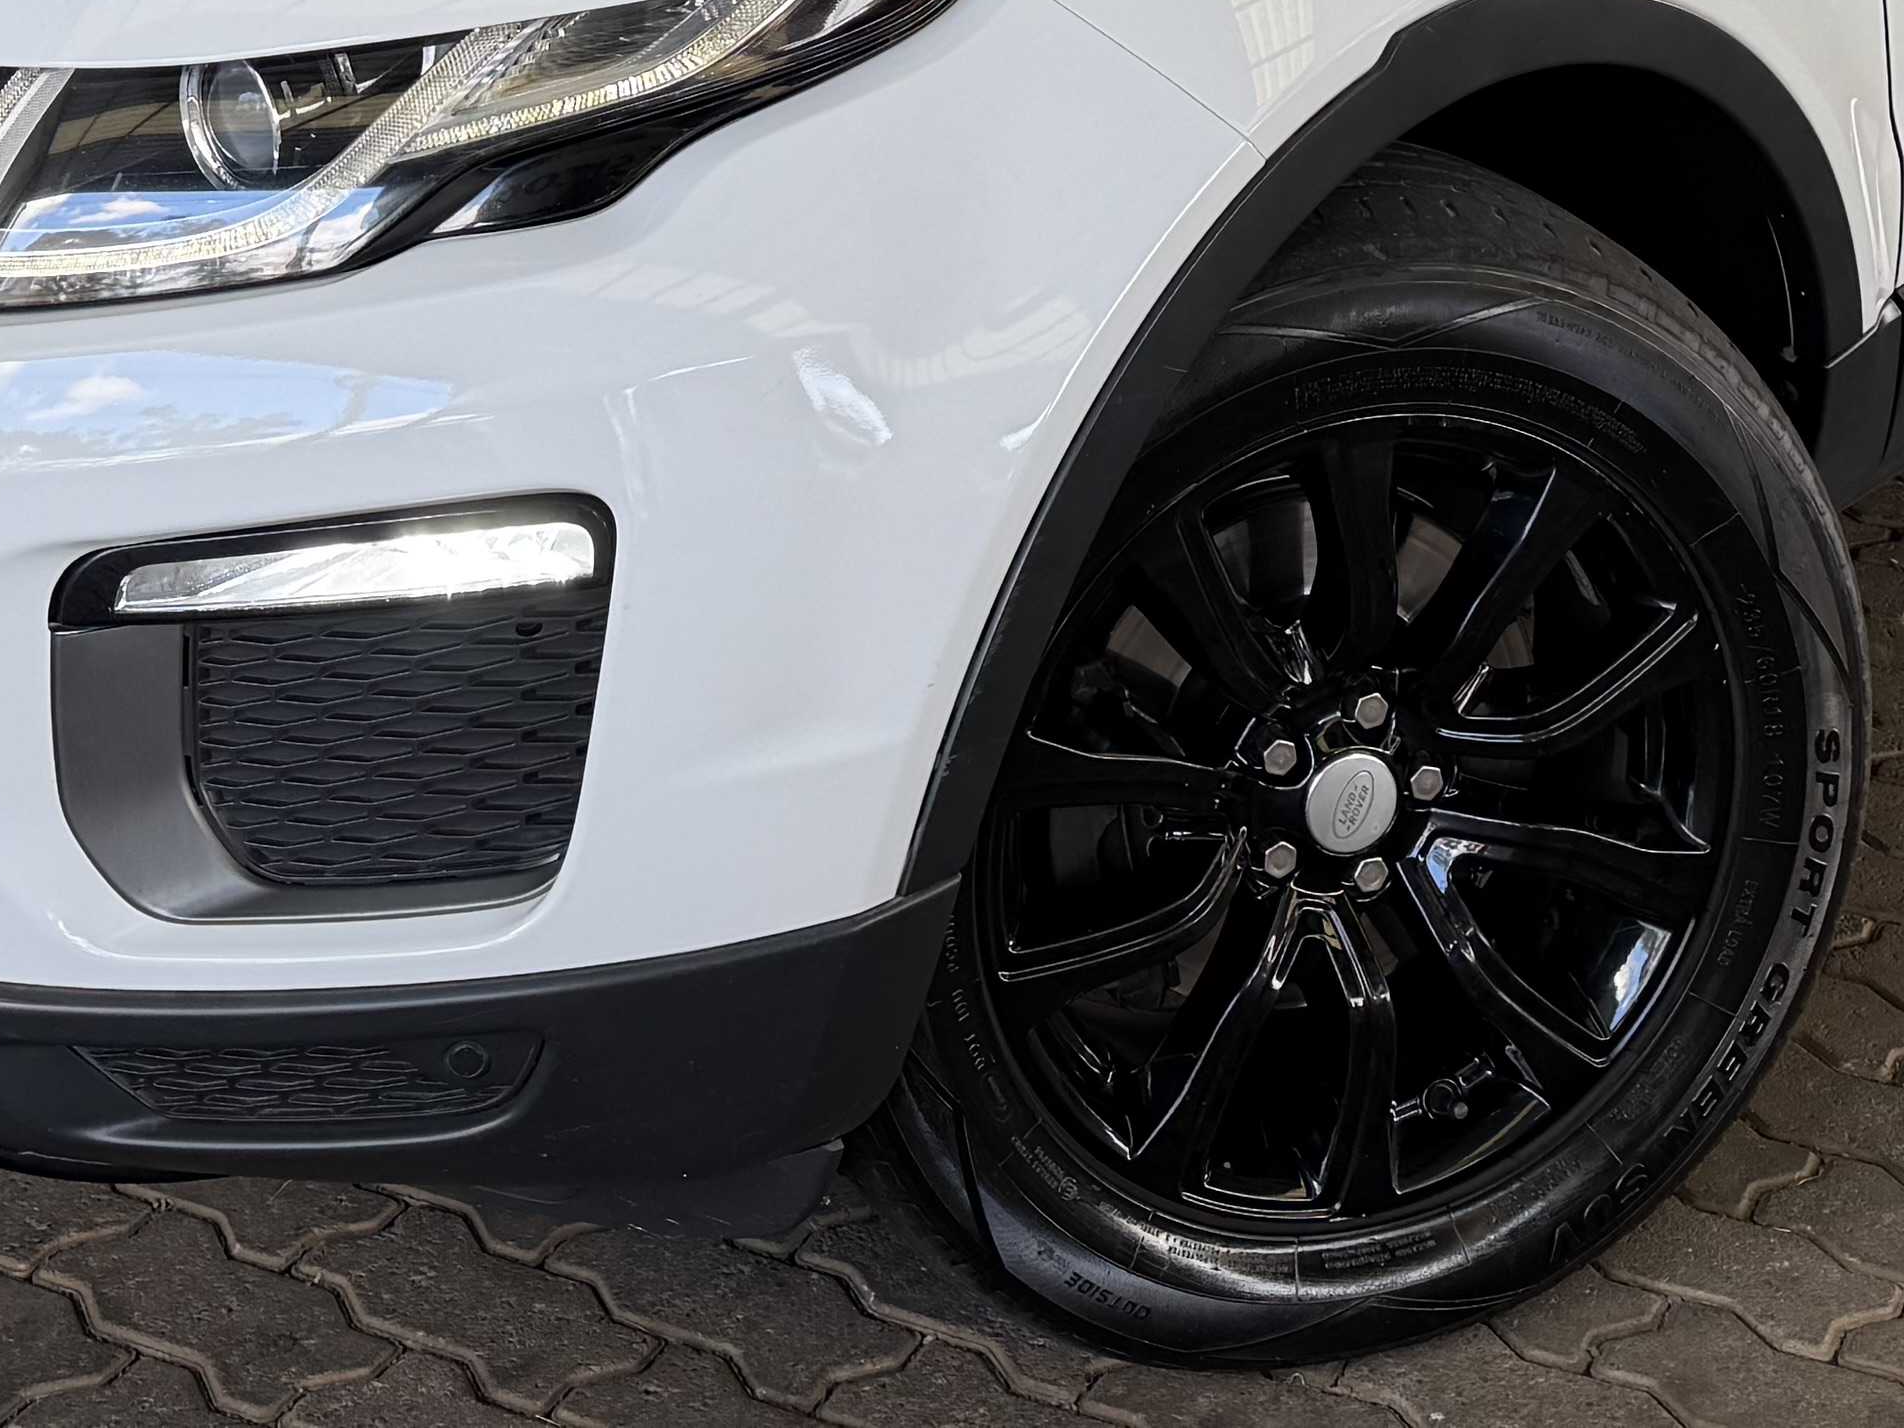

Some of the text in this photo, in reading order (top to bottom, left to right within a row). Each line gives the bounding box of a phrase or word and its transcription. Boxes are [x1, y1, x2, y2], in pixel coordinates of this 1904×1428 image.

[1338, 792, 1357, 825] LAND
[1349, 785, 1370, 826] ROVER
[1791, 727, 1841, 938] SPORT
[1064, 1271, 1152, 1321] OUTSIDE
